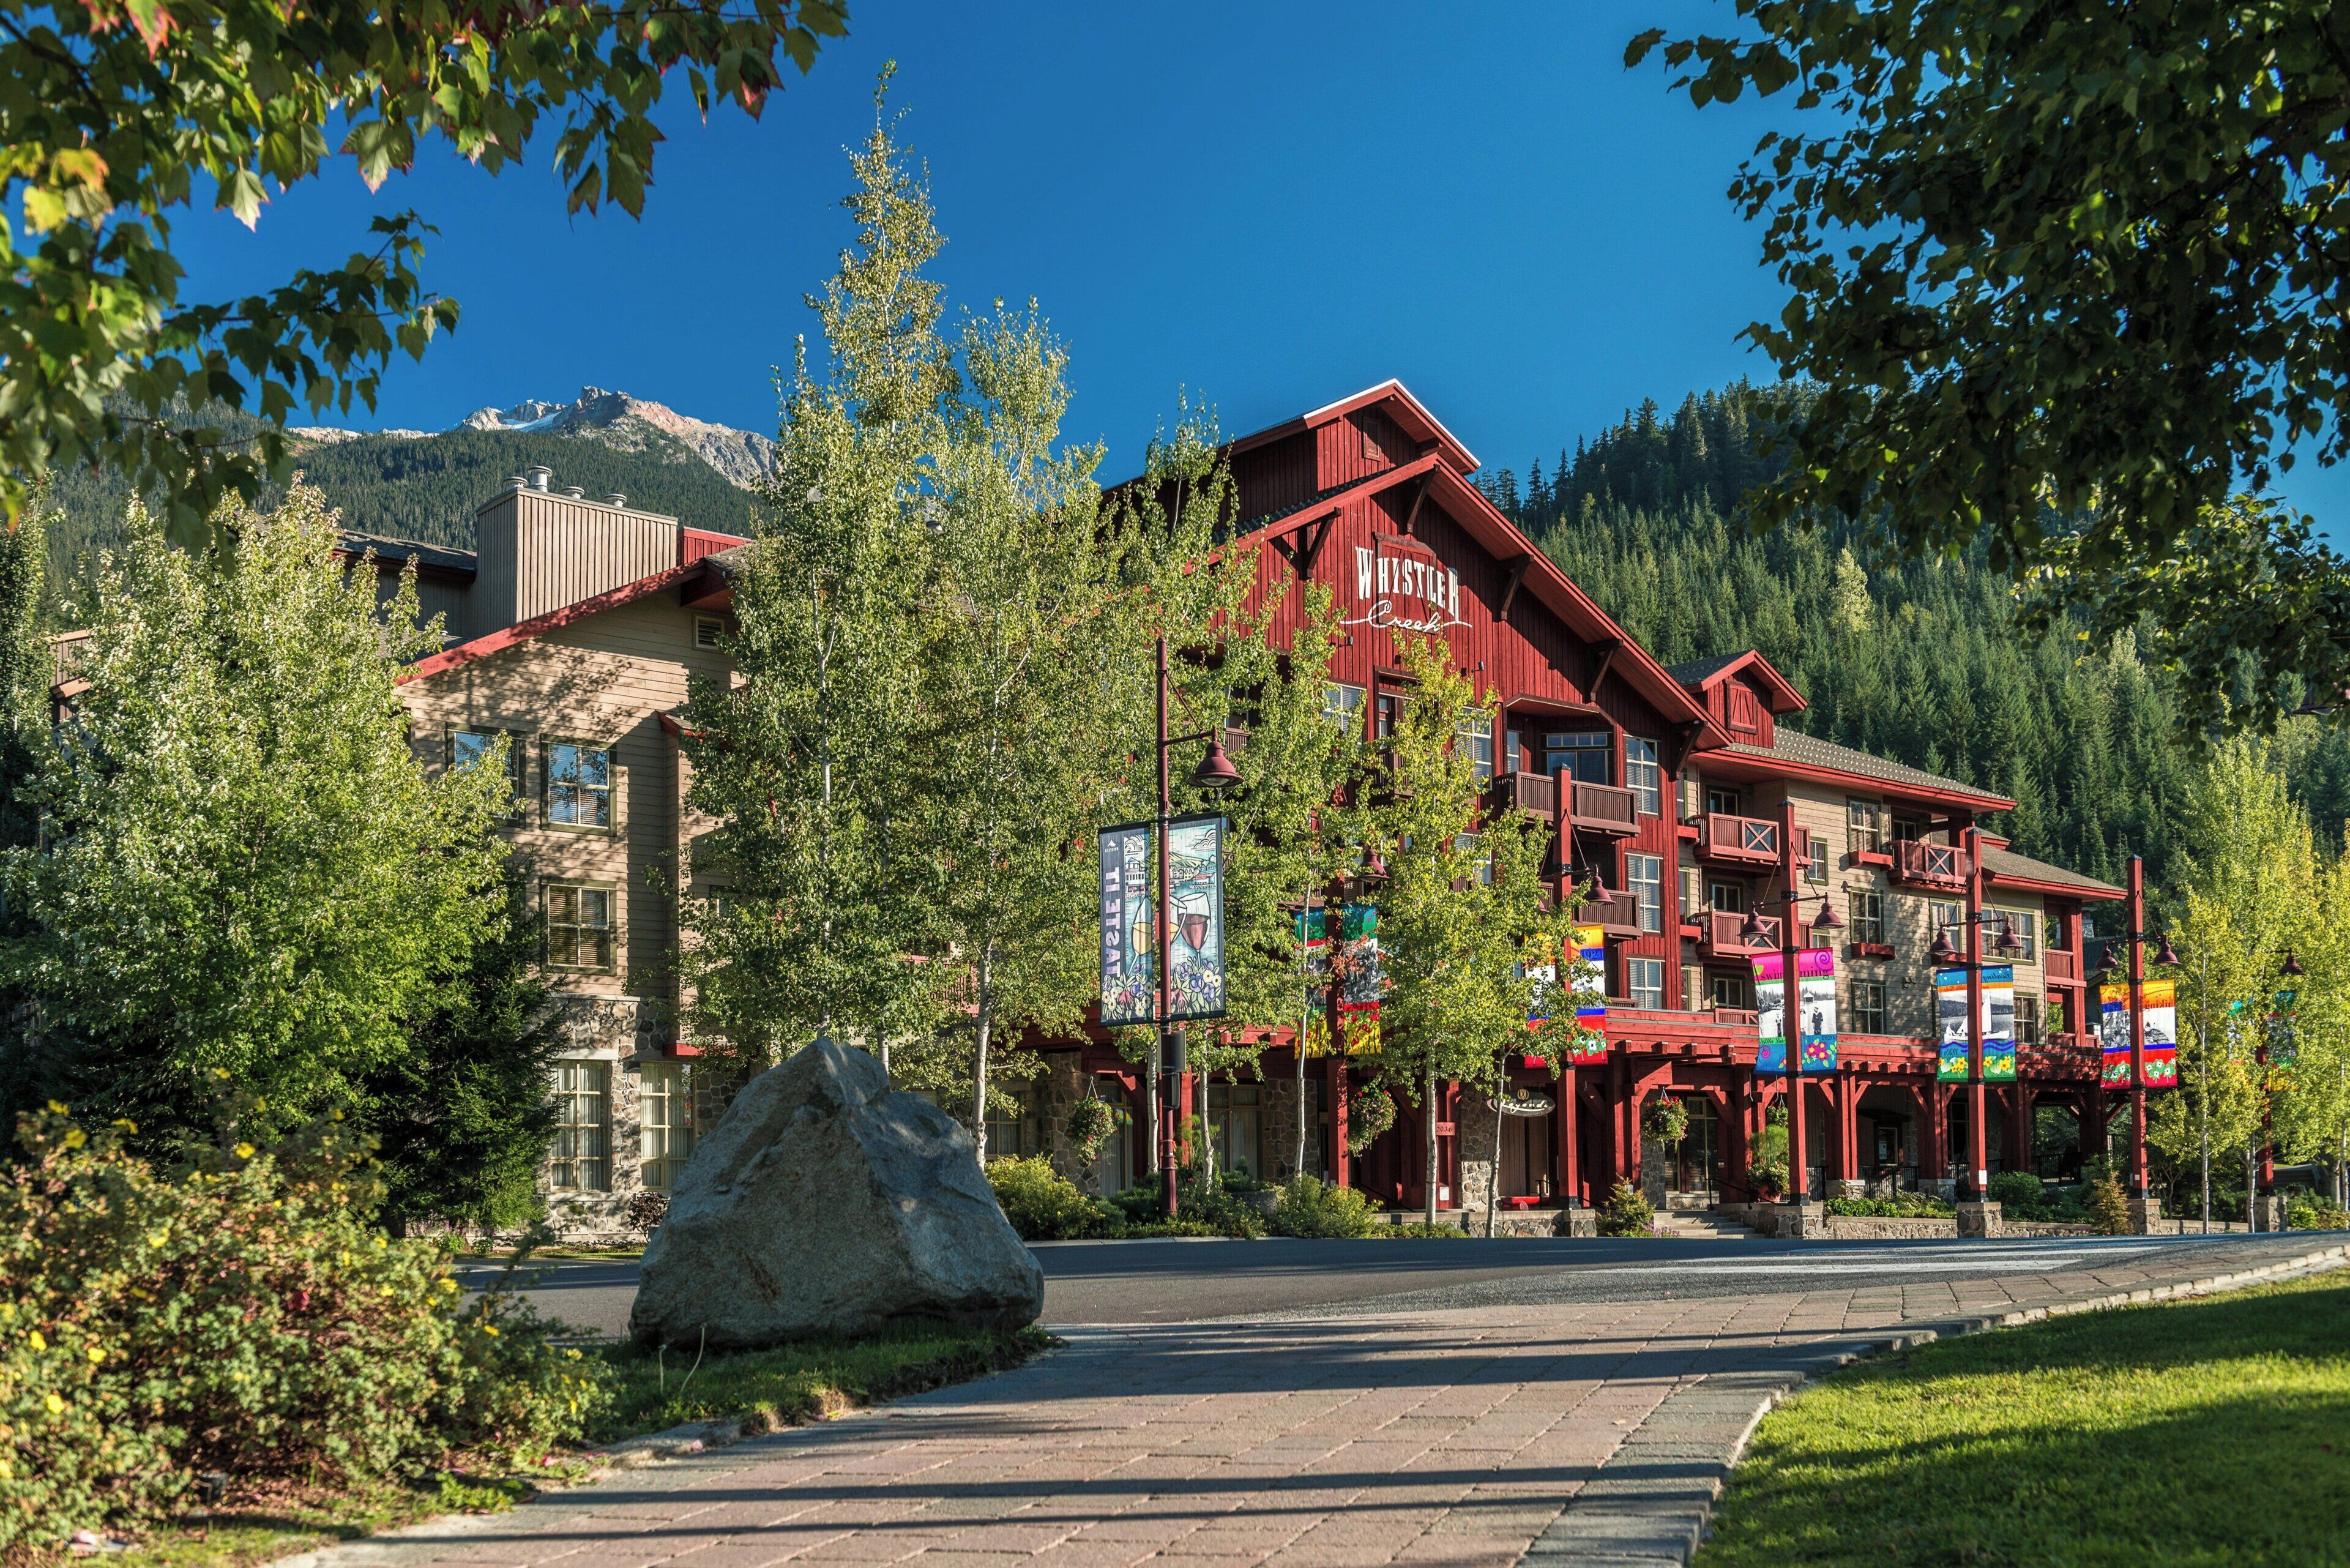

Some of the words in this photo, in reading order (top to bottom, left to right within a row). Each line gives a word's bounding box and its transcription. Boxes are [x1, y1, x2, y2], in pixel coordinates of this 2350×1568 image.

[1356, 546, 1459, 622] WHISTLER
[1340, 600, 1473, 632] Creek
[1581, 949, 1602, 960] 1921
